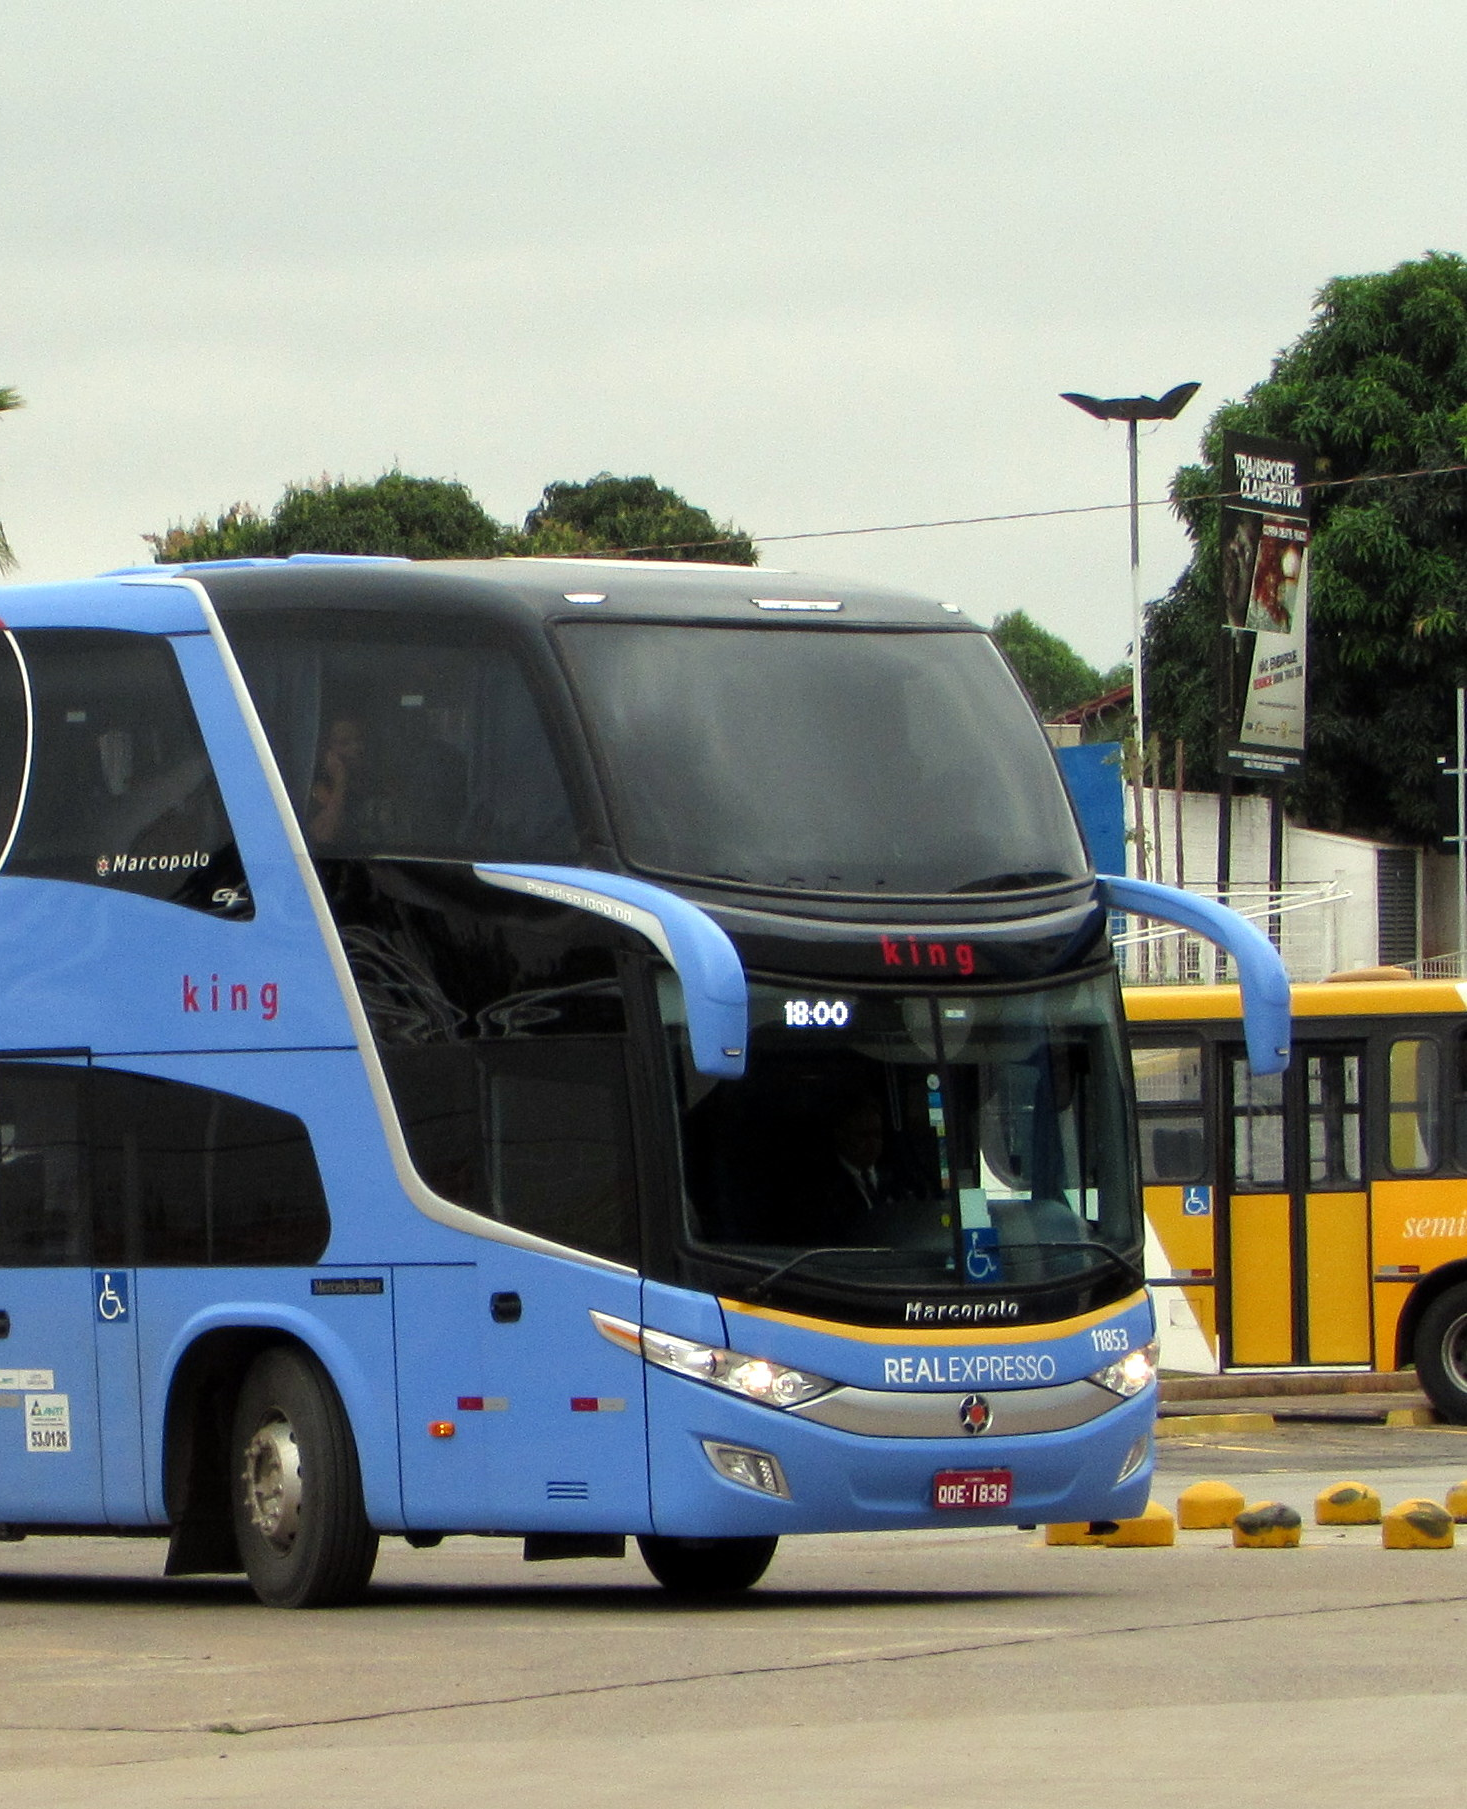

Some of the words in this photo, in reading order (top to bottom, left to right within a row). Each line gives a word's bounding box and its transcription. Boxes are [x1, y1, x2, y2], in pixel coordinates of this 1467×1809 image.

[1234, 453, 1296, 485] TRANSPORTE
[1239, 477, 1302, 508] CLANDESTINO
[113, 851, 210, 872] Marcopolo
[880, 934, 975, 975] king
[183, 973, 278, 1020] king
[784, 1001, 849, 1026] 18:00
[1402, 1209, 1467, 1238] semi
[905, 1300, 1019, 1321] Marcopolo
[1091, 1328, 1129, 1351] 11853
